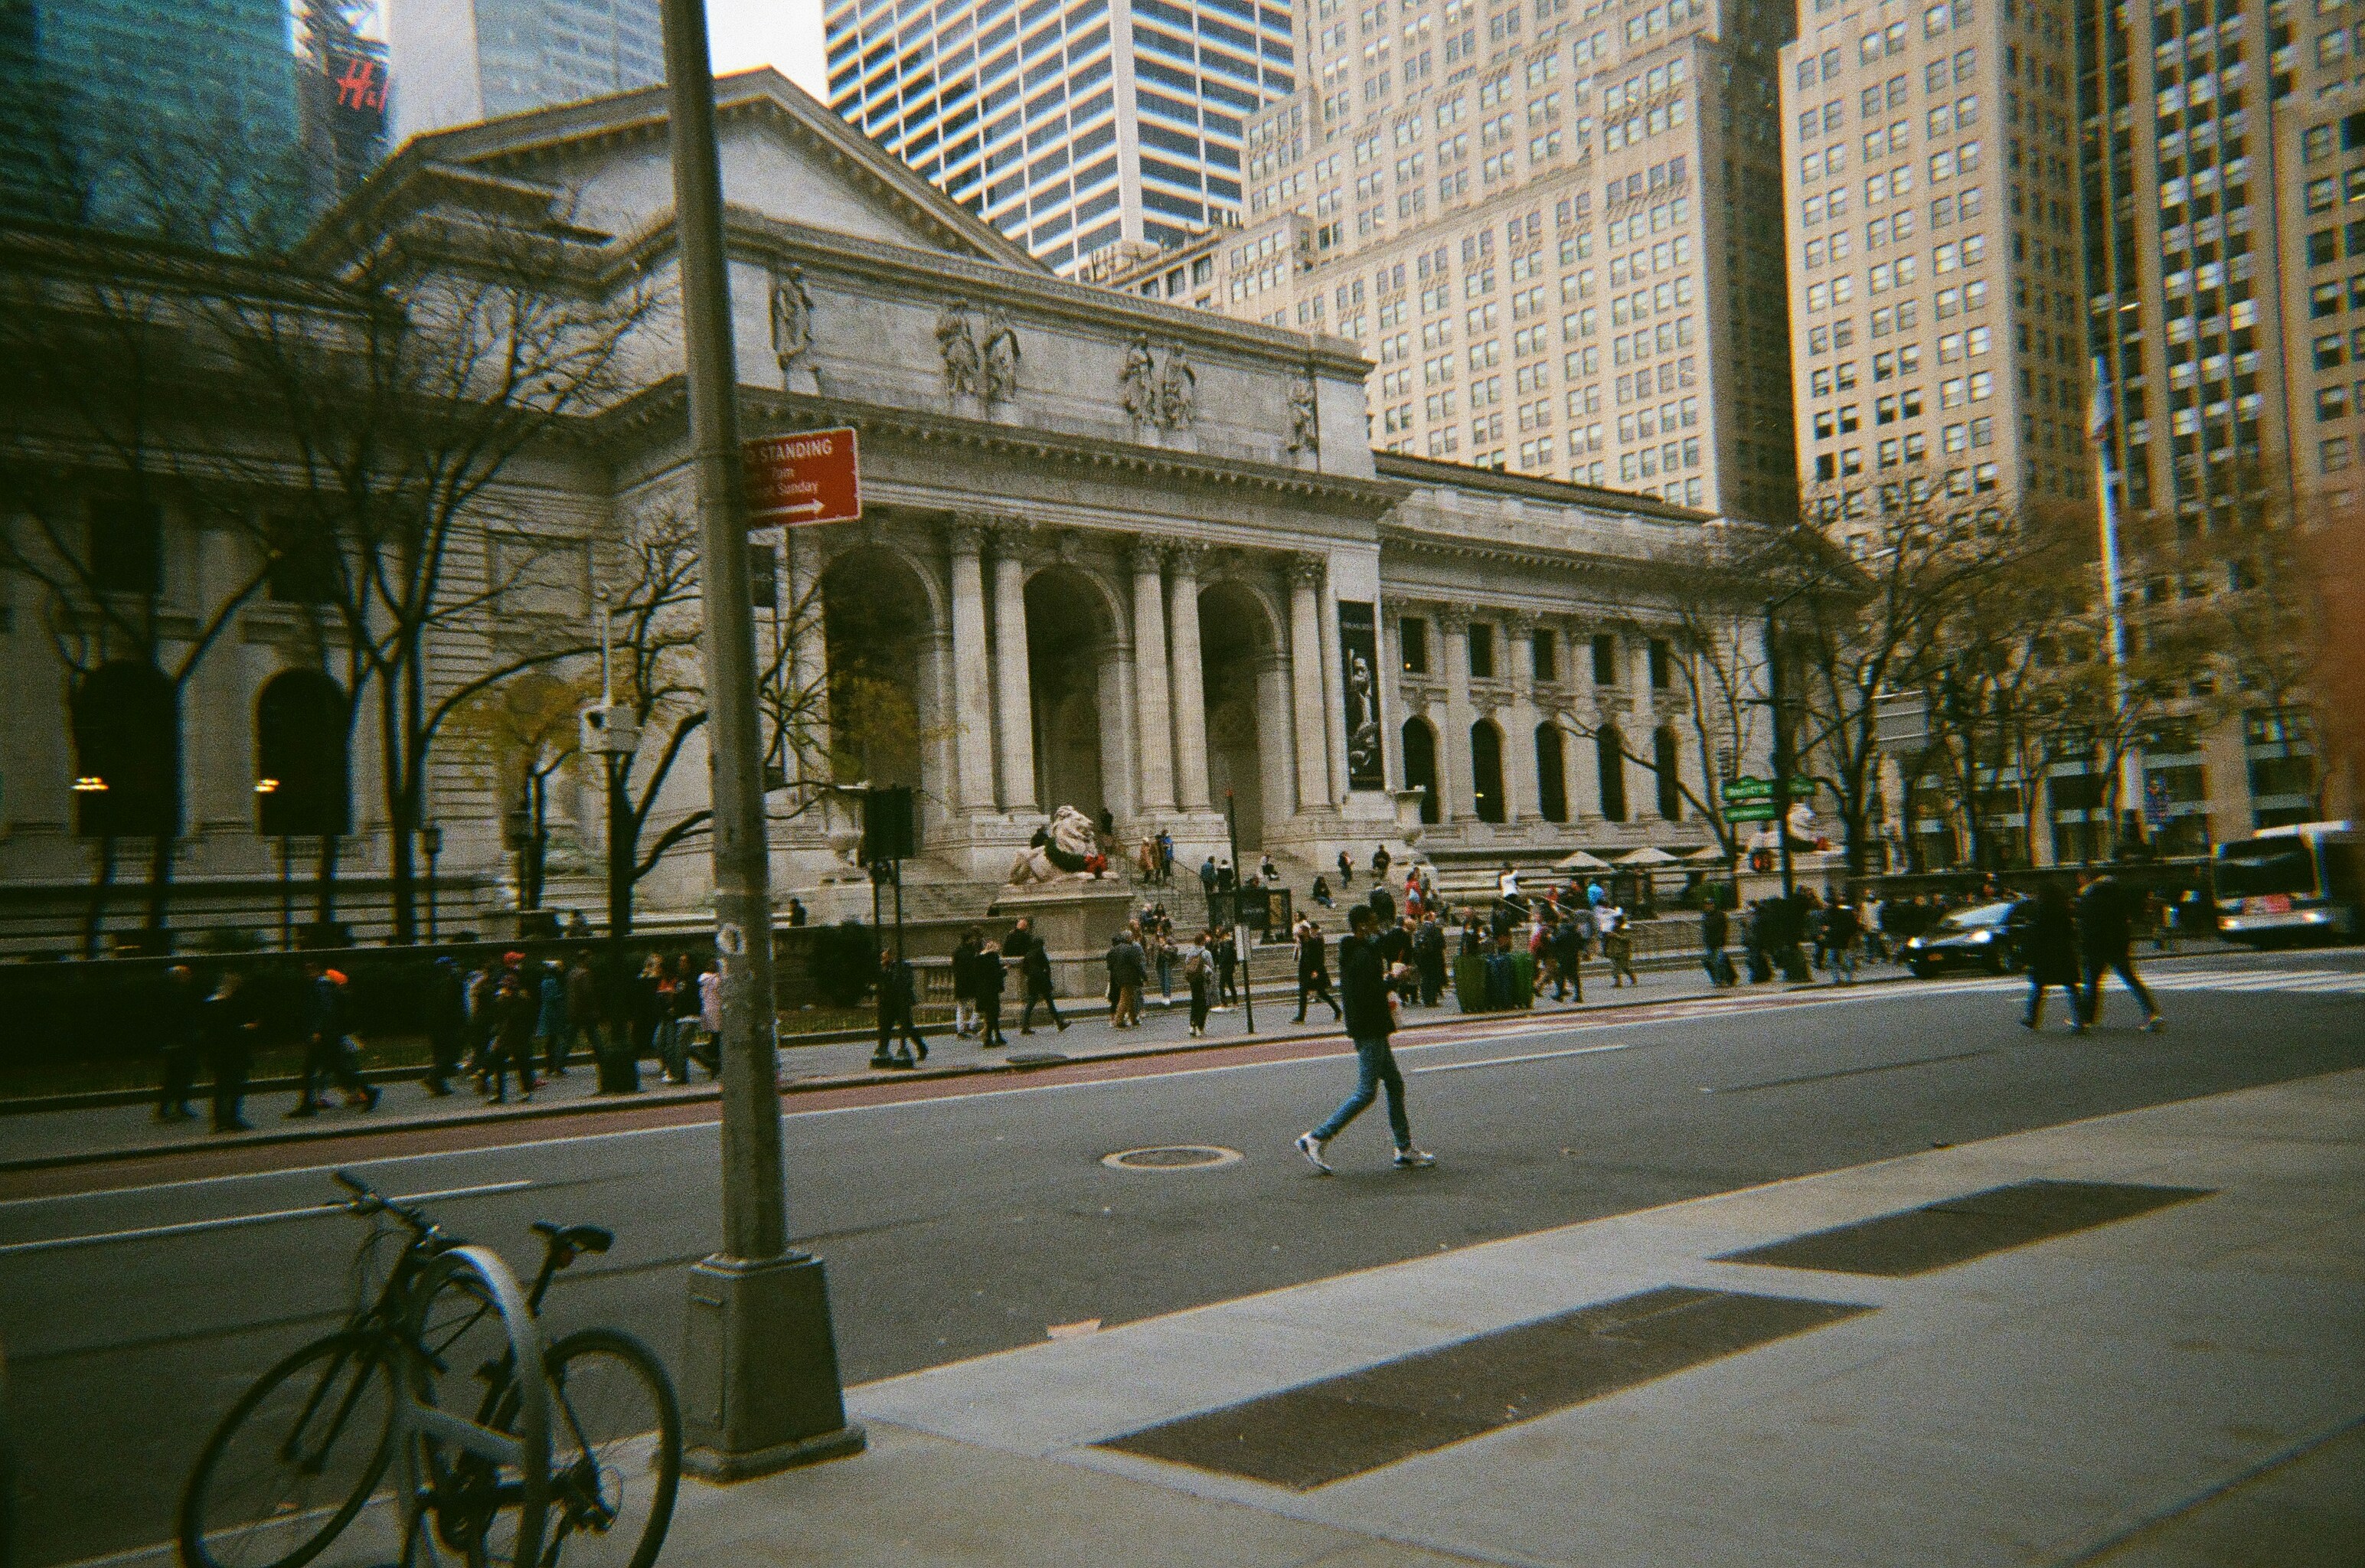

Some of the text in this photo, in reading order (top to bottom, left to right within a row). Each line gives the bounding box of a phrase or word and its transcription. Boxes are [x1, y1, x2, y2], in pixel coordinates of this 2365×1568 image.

[336, 58, 389, 113] H&
[759, 437, 833, 464] STANDING
[777, 479, 818, 496] Sunday
